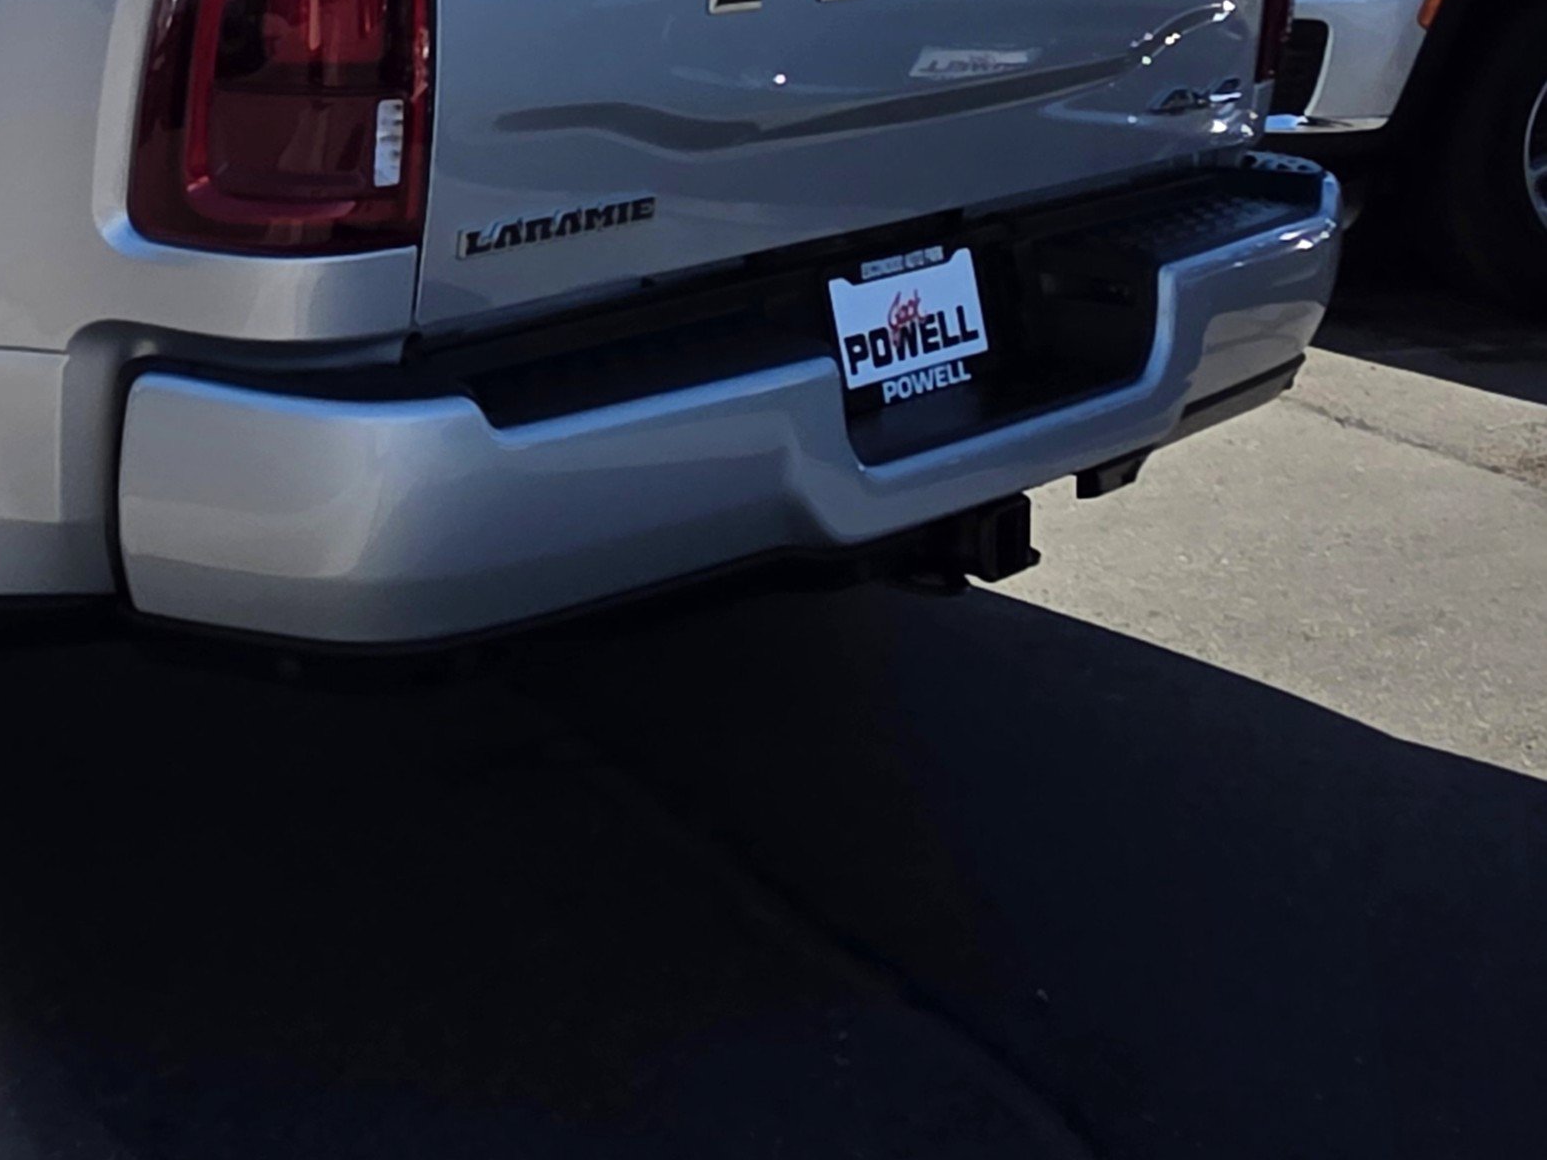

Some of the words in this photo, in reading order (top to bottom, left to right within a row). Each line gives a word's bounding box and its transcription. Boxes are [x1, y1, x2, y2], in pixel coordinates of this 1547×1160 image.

[456, 195, 656, 259] LARAMIE
[844, 305, 979, 375] POWELL
[882, 360, 972, 404] POWELL
